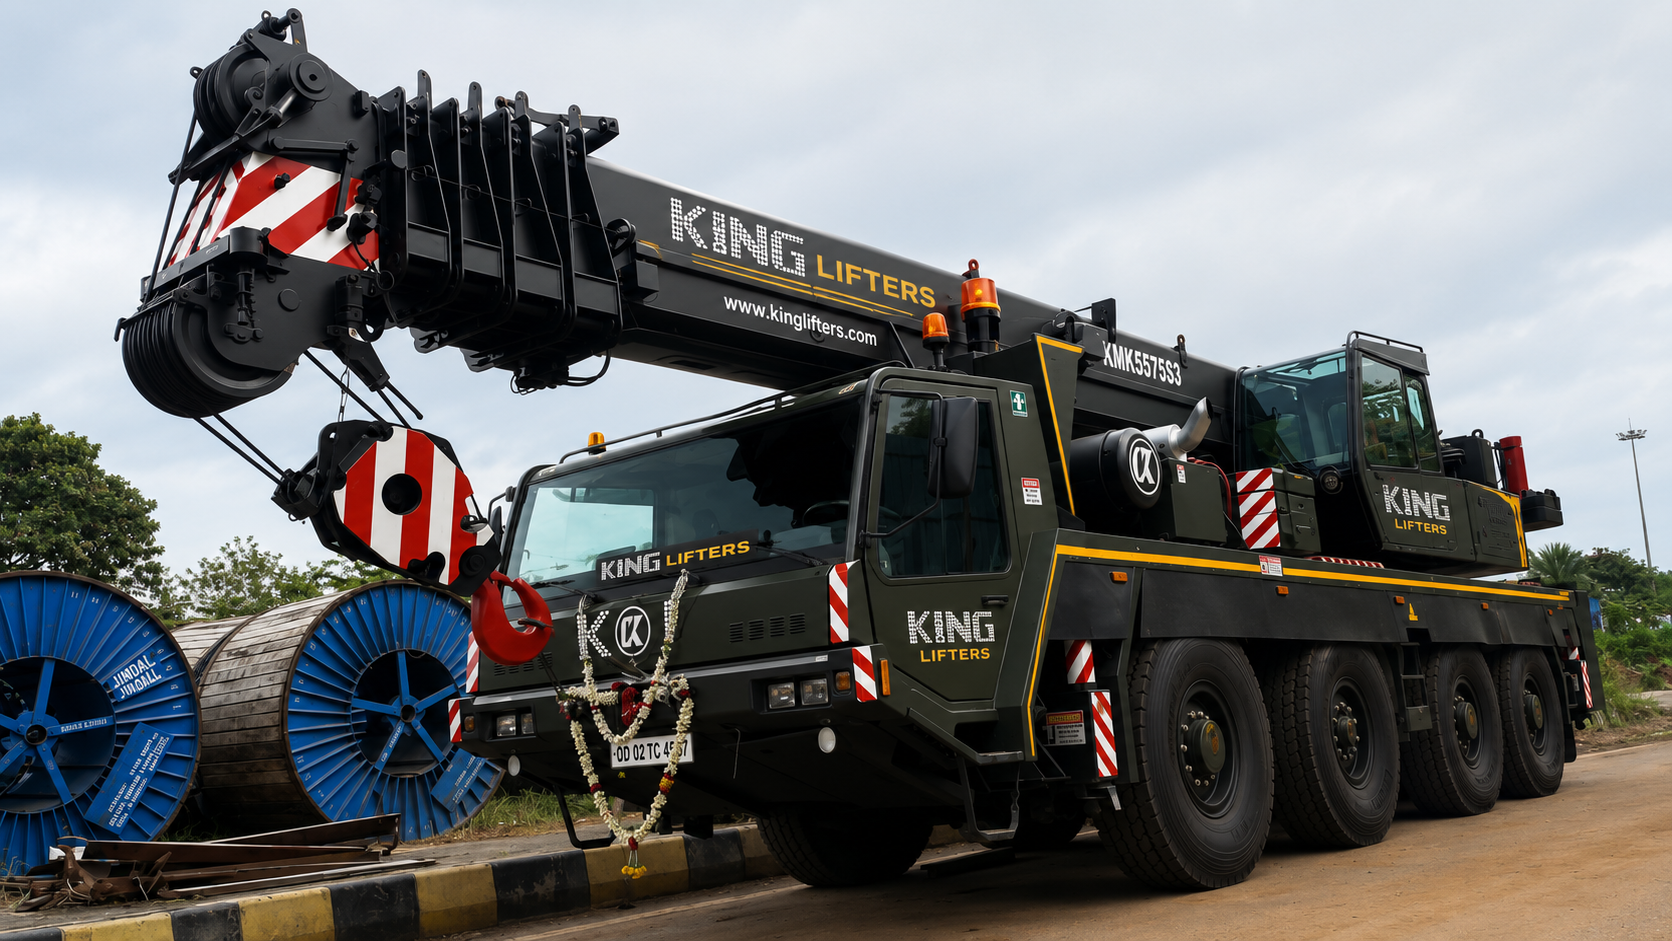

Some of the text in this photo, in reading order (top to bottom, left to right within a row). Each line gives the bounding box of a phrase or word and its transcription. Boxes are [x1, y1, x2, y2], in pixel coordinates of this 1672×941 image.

[670, 197, 936, 309] KING LIFTERS
[723, 296, 878, 347] www.kinglifters.com
[1382, 484, 1451, 522] KING
[1394, 518, 1448, 535] LIFTERS
[601, 540, 750, 581] KING LIFTERS
[907, 610, 996, 644] KING
[920, 647, 991, 662] LIFTERS
[616, 745, 630, 763] OD
[633, 743, 645, 761] 02
[646, 742, 661, 760] TC
